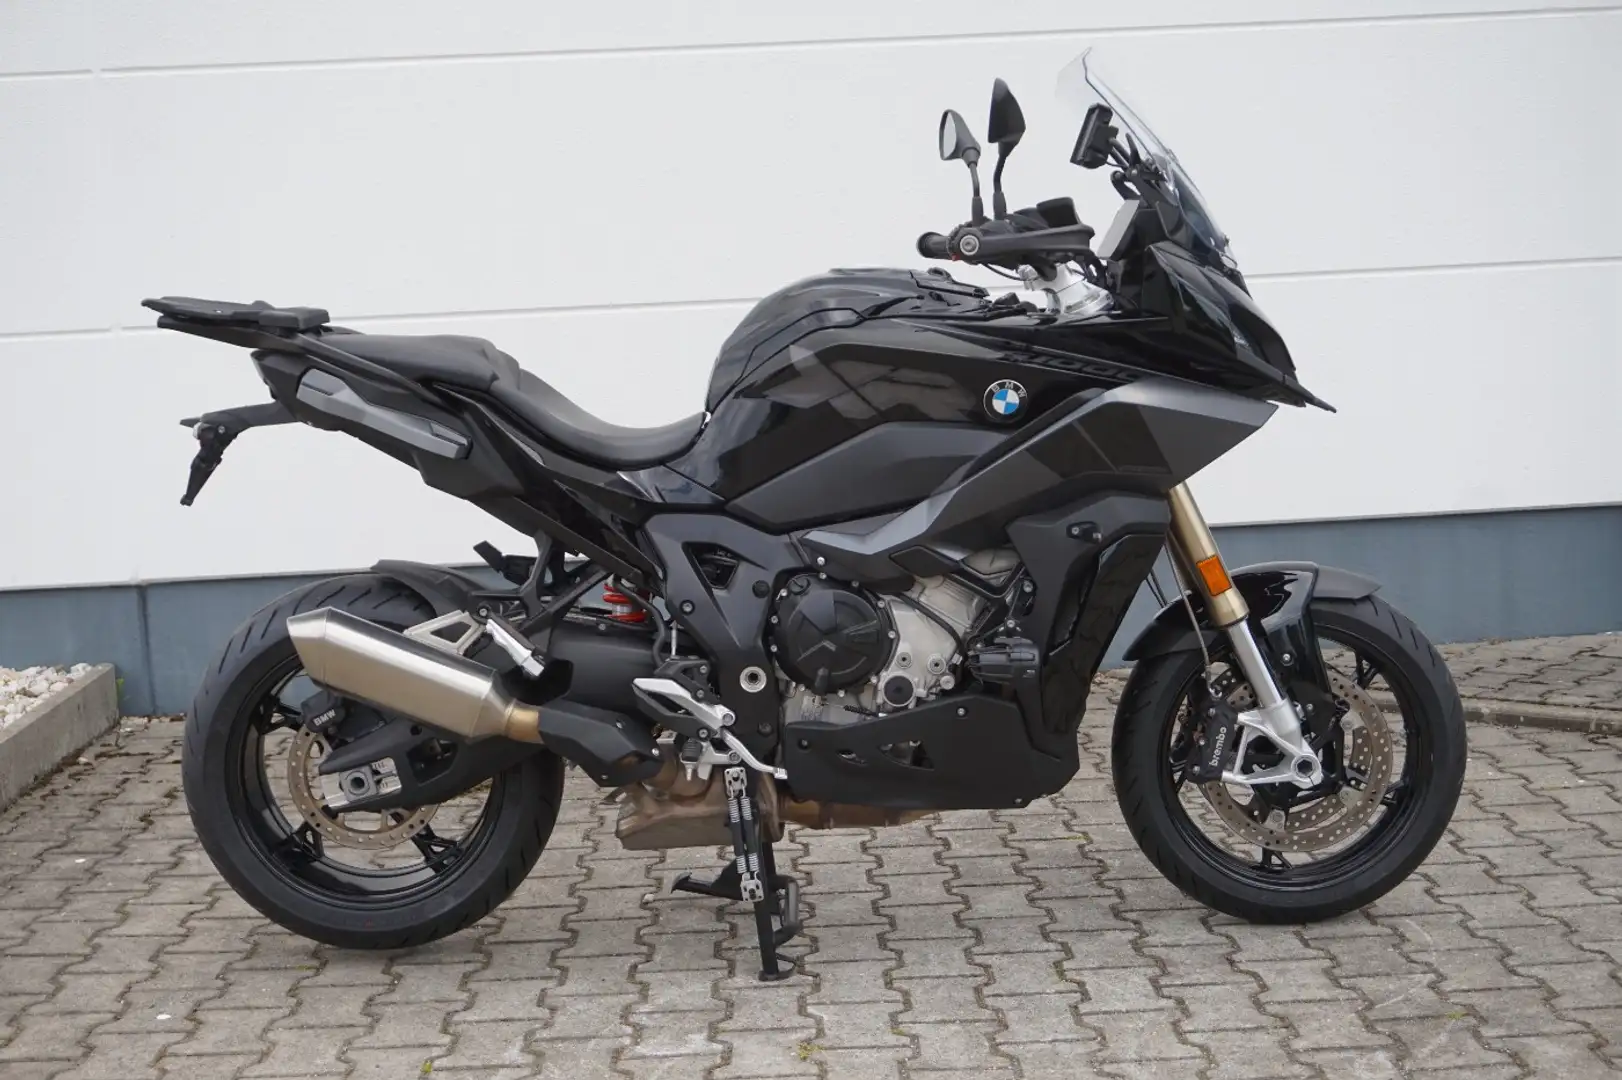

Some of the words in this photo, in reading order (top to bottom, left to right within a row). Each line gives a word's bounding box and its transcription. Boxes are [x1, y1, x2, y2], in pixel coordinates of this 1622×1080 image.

[991, 381, 1027, 398] BMW
[313, 709, 336, 726] BMW
[1208, 726, 1227, 767] brembo
